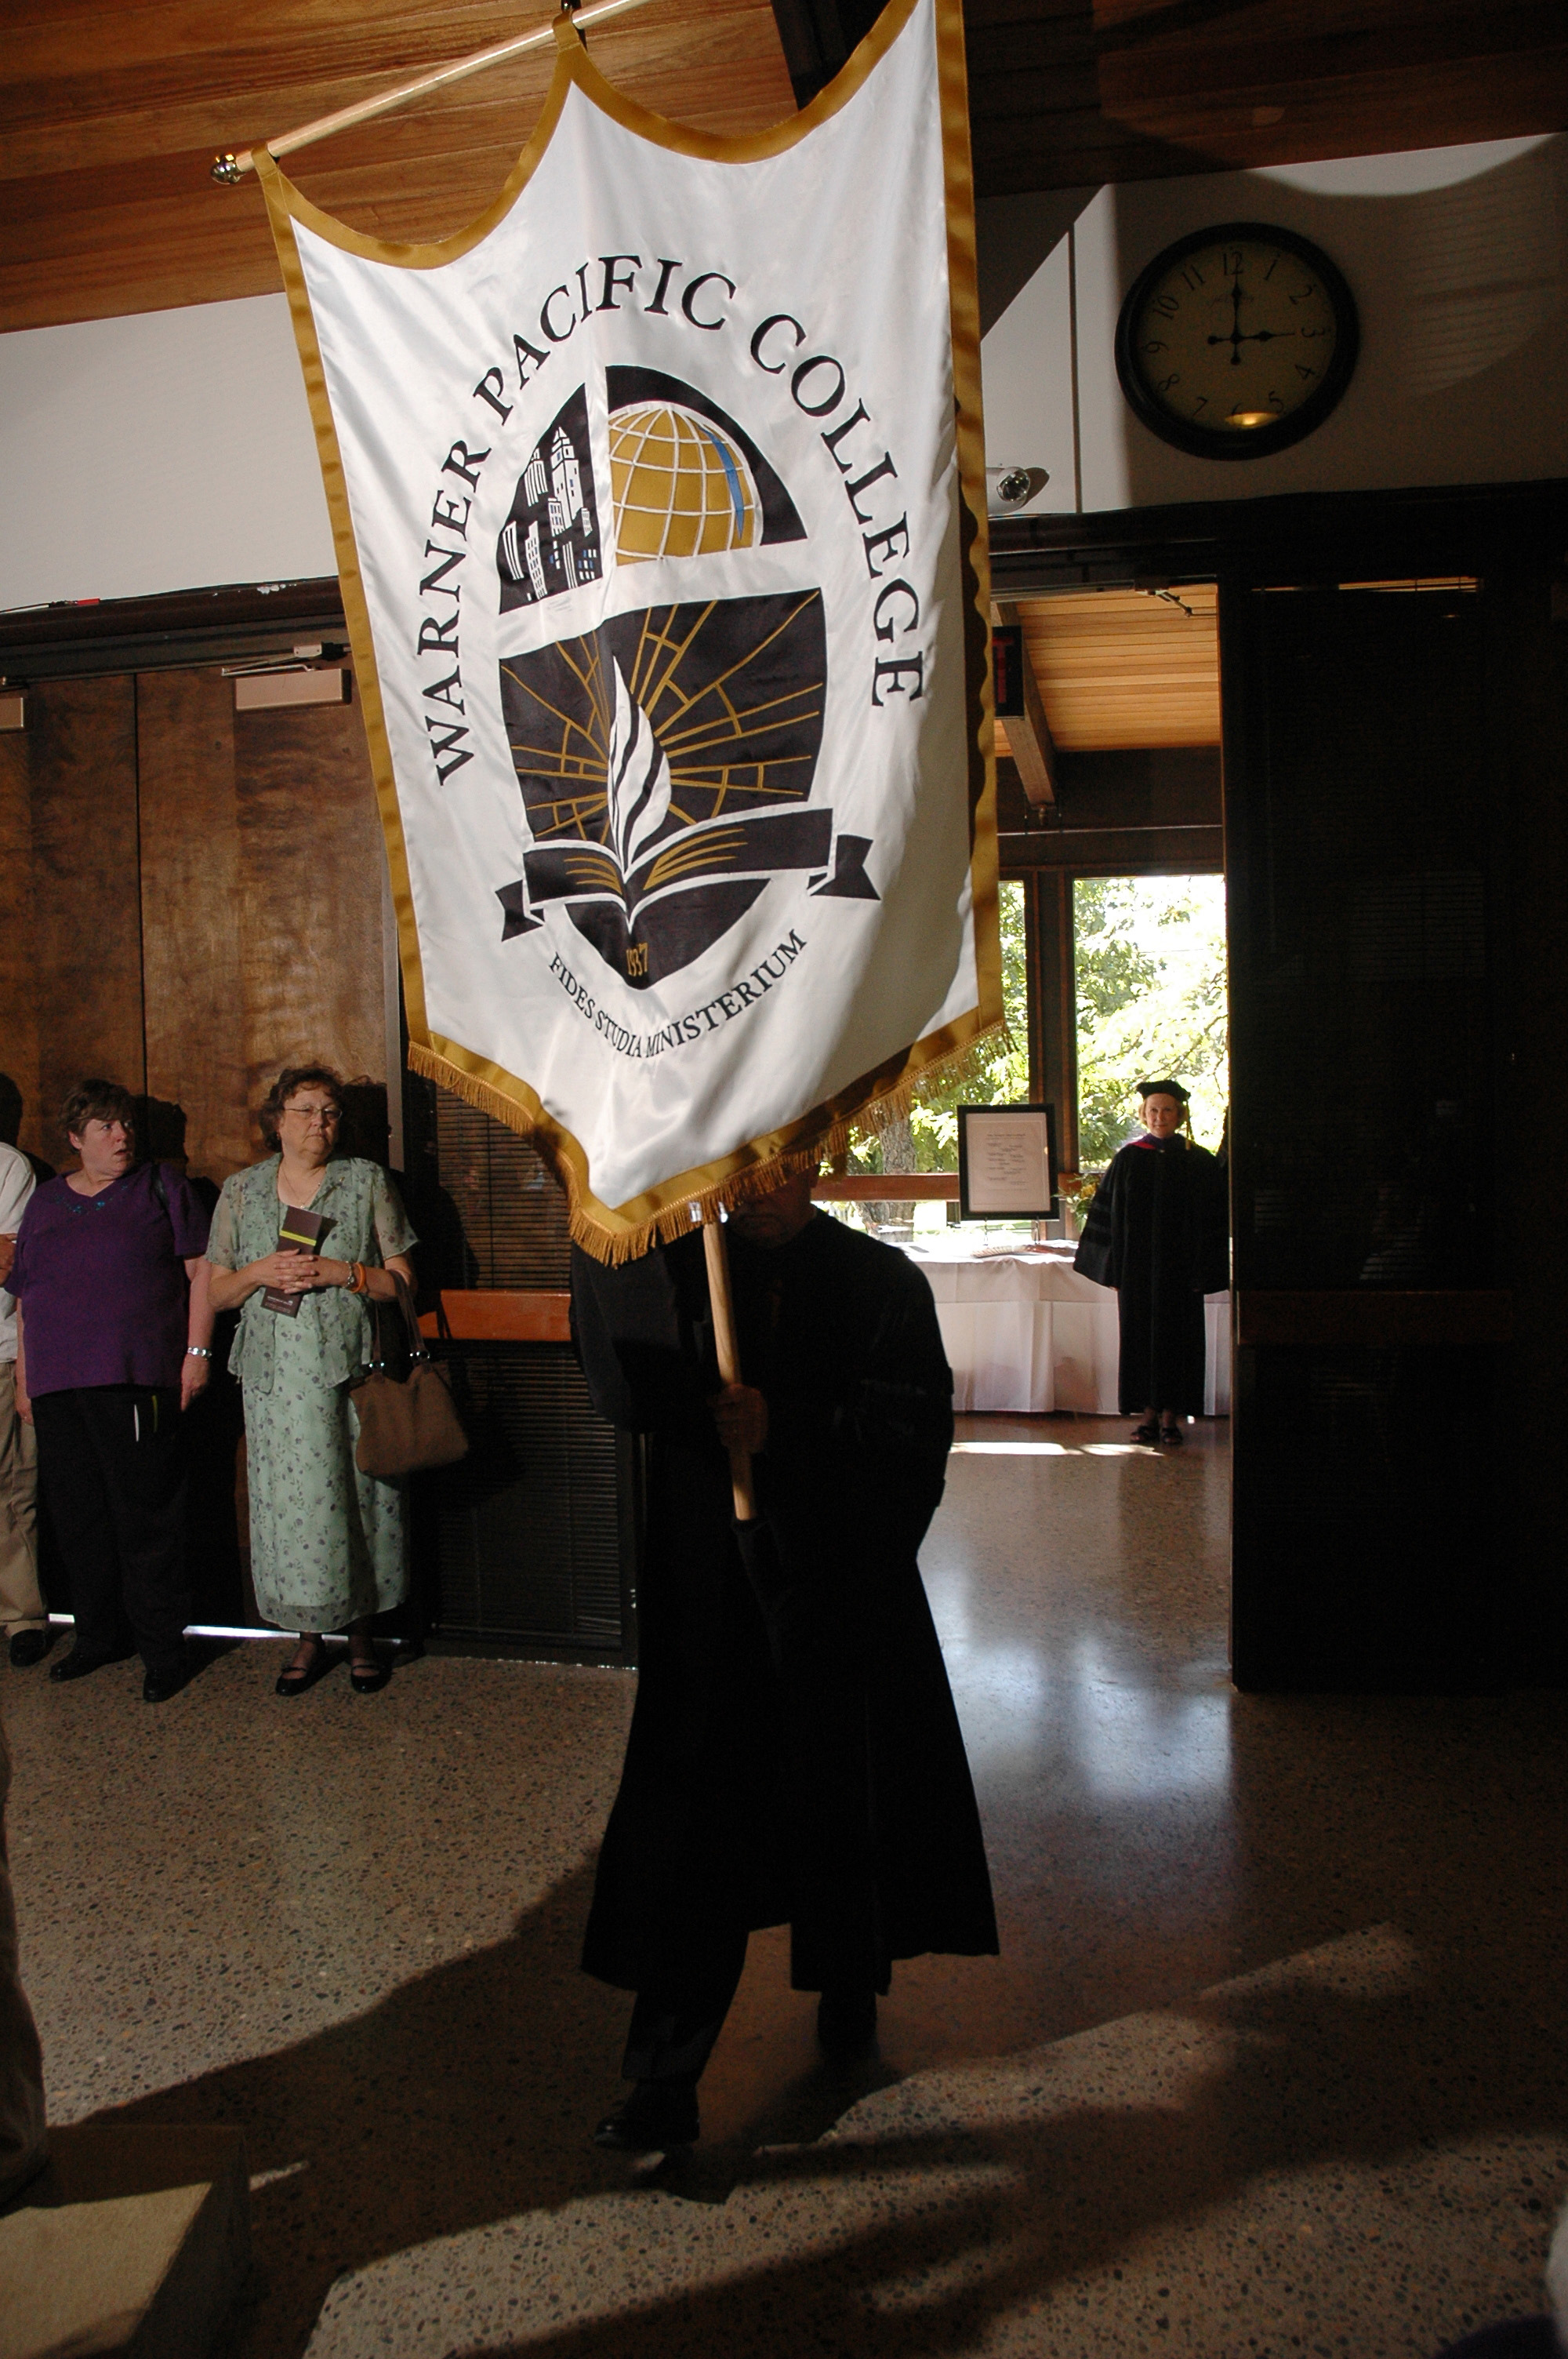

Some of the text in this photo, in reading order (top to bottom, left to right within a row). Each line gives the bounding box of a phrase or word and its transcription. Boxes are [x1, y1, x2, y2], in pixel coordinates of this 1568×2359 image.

[1222, 251, 1243, 275] 12
[1181, 264, 1207, 291] 11
[1289, 283, 1317, 304] 2
[1153, 295, 1179, 320] 10
[1301, 327, 1328, 338] 3
[1143, 340, 1169, 354] 9
[1157, 373, 1179, 392] 8
[1294, 364, 1318, 380] 4
[1192, 396, 1208, 417] 7
[1269, 391, 1284, 413] 5
[417, 255, 924, 786] WARNER PACIFIC COLLEGE
[549, 929, 807, 1058] FIDES STUDIA MINISTERIUM
